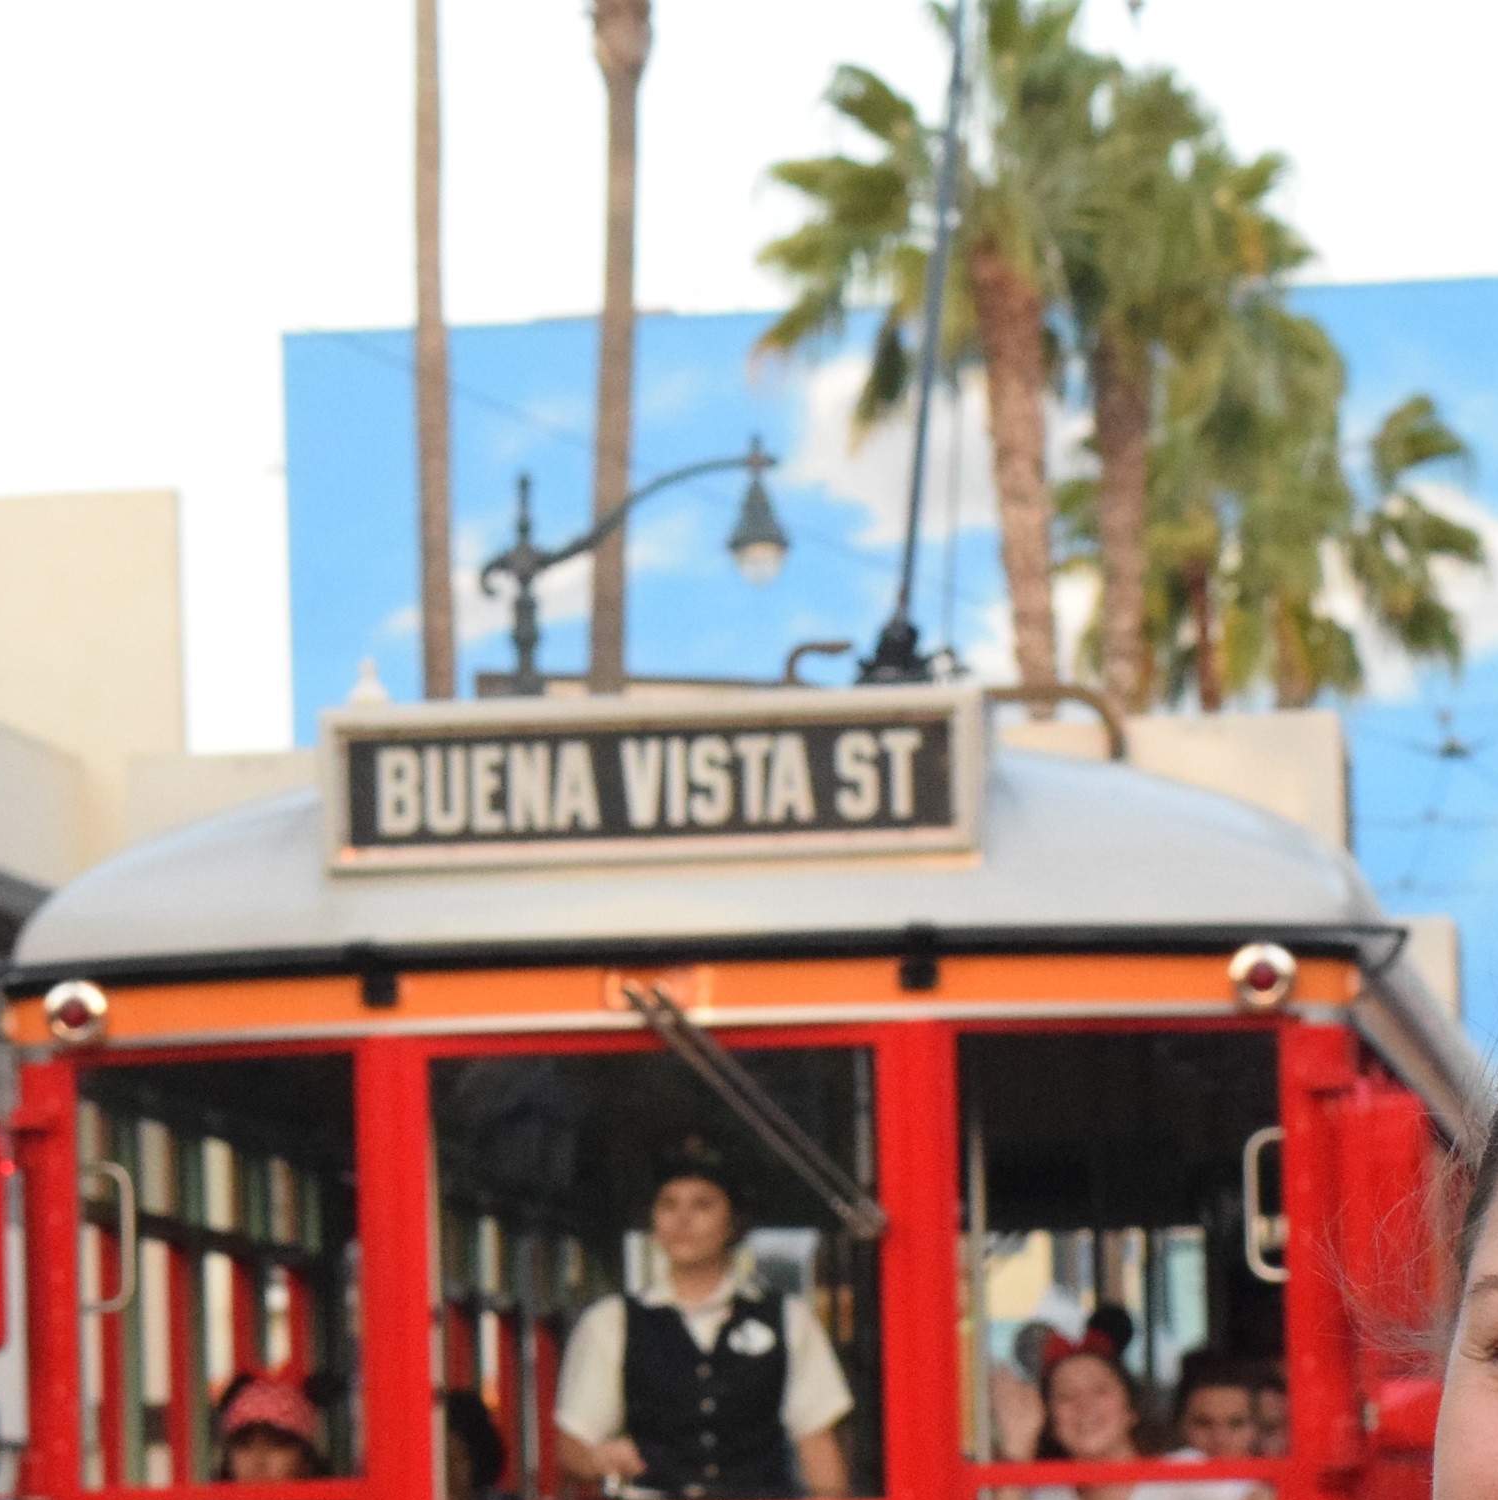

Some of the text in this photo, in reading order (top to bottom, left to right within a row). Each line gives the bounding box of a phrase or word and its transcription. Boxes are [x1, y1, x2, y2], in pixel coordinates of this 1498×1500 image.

[374, 726, 923, 837] BUENA VISTA ST
